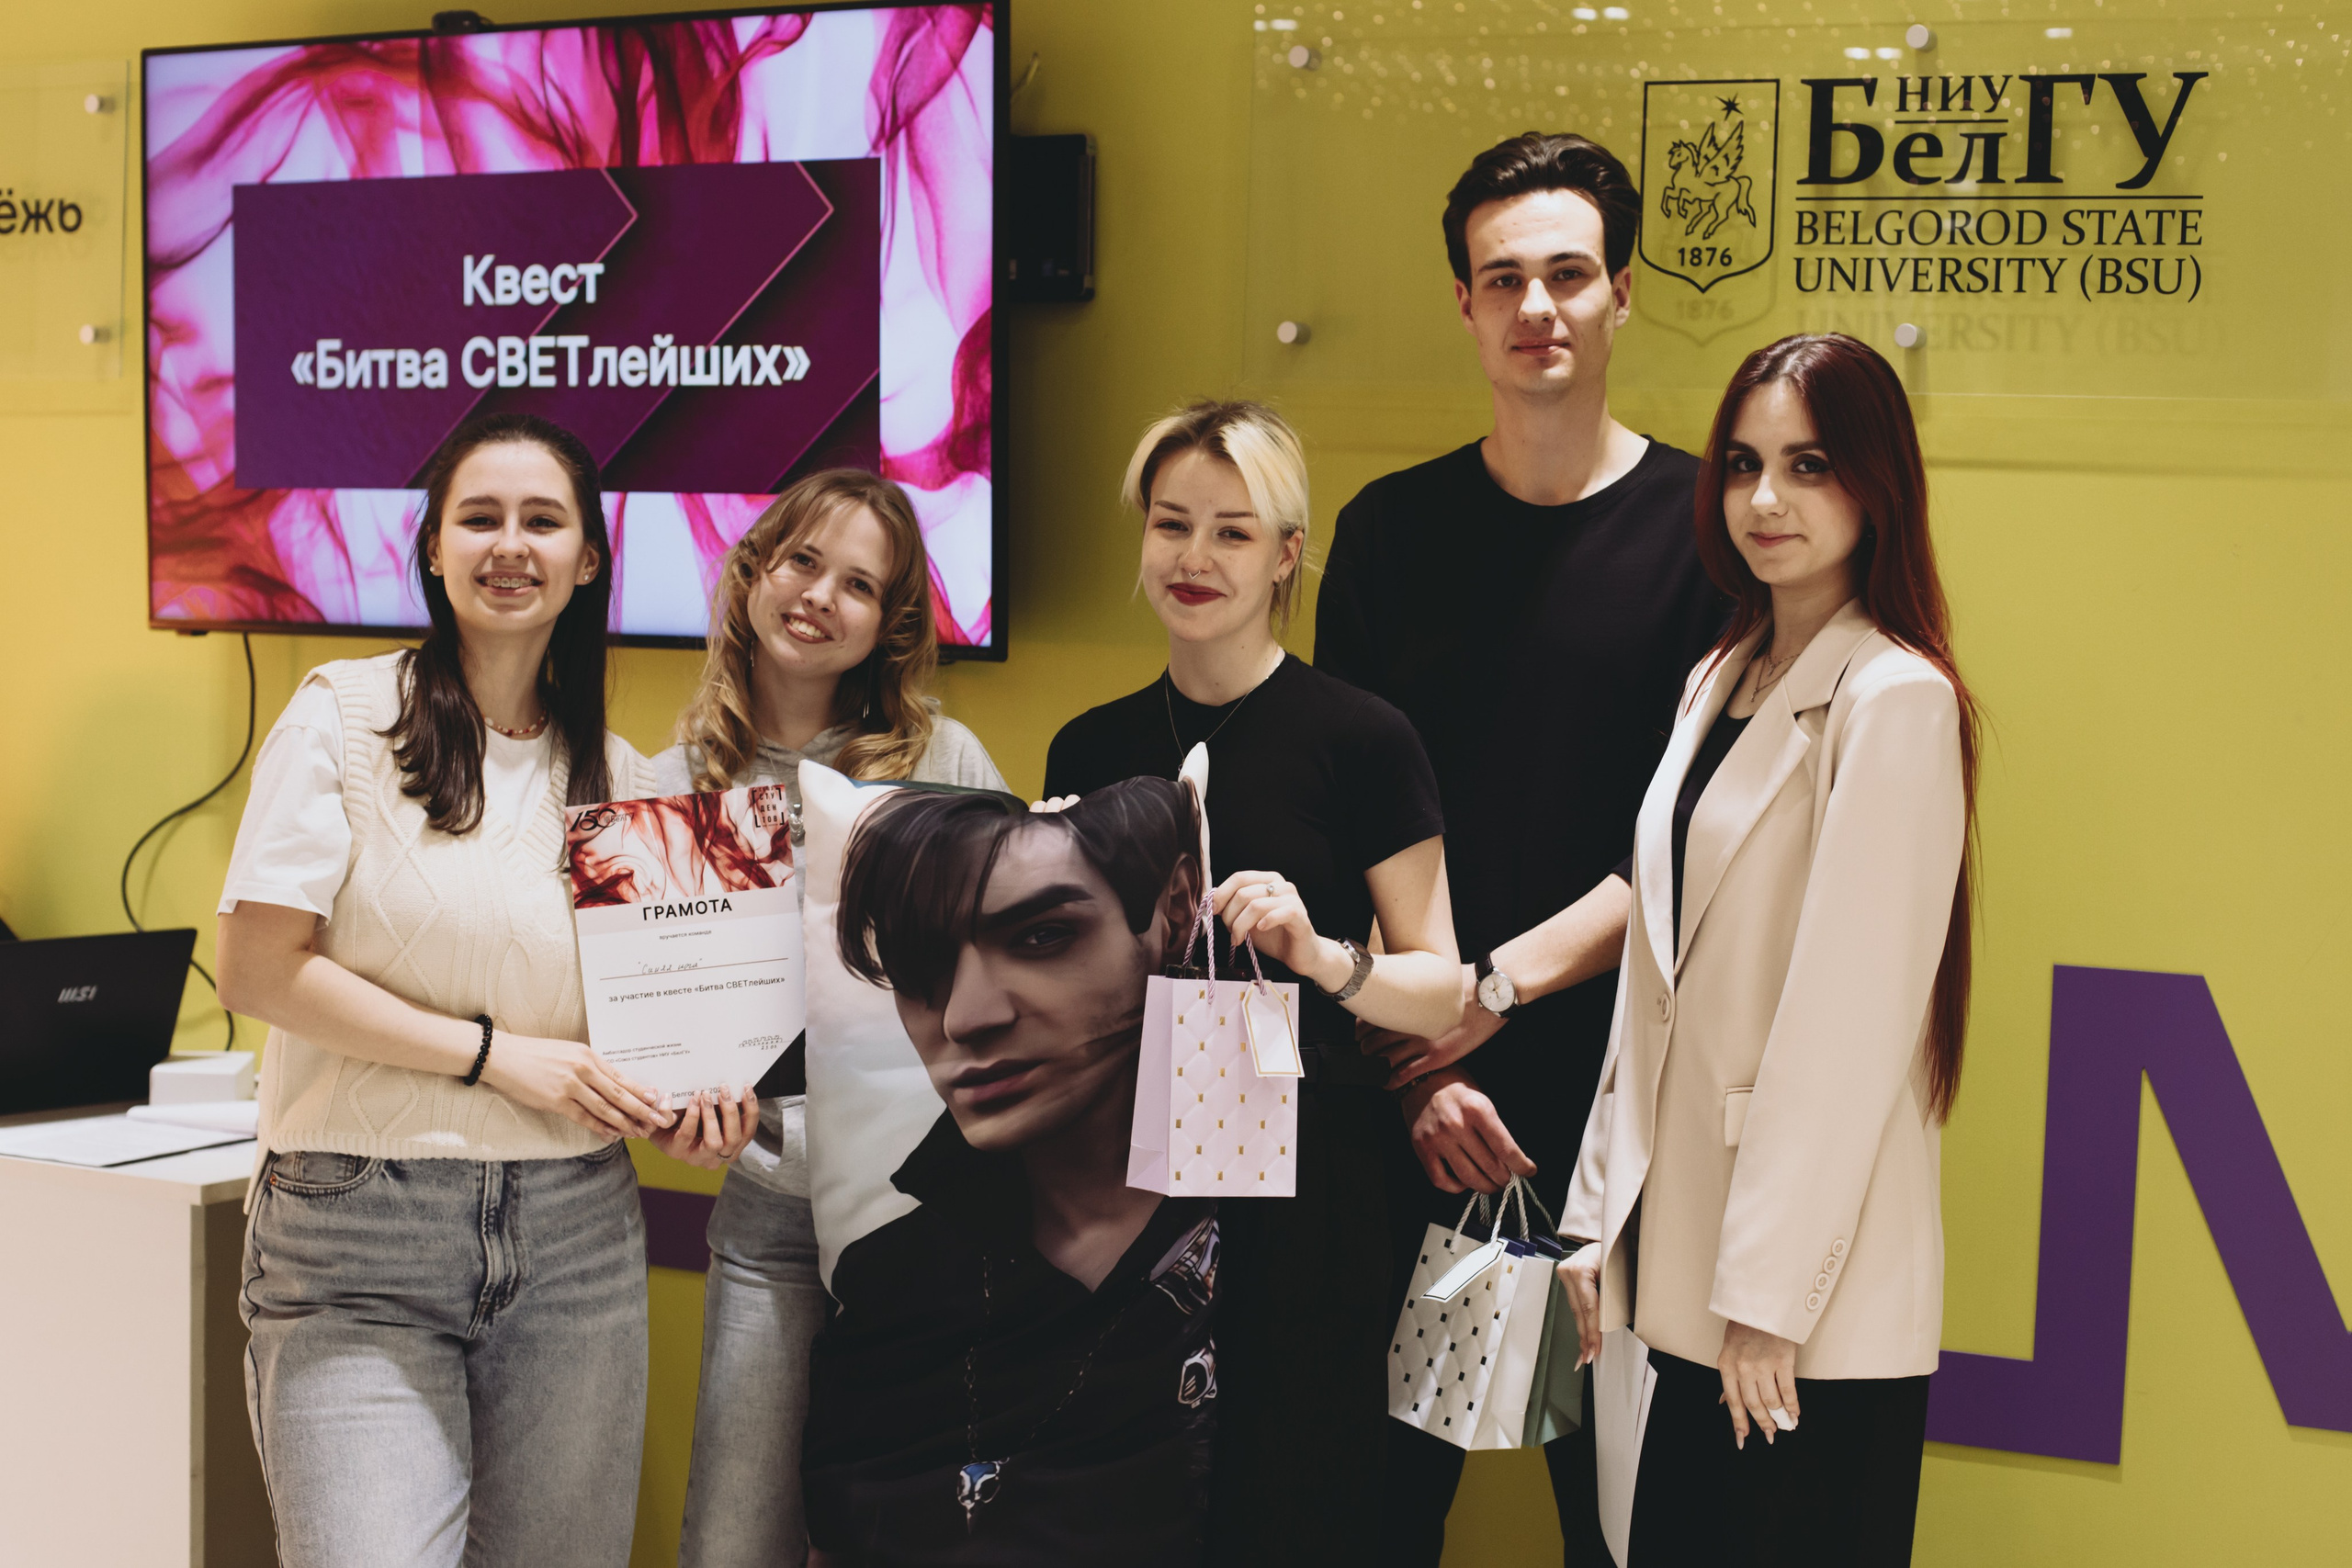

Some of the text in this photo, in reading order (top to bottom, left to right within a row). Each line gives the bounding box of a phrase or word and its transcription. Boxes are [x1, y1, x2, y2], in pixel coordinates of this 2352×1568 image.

[1895, 74, 2013, 113] НИУ
[1796, 72, 2210, 189] БелГУ
[1794, 209, 2203, 246] BELGOROD STATE
[1678, 246, 1733, 267] 1876
[462, 254, 605, 306] Квест
[1794, 254, 2202, 303] UNIVERSITY (BSU)
[290, 333, 811, 389] «Битва СВЕТлейших»
[643, 897, 732, 920] ГРАМОТА
[620, 991, 654, 1002] участие
[663, 987, 693, 996] квесте
[695, 983, 724, 993] «Битва
[726, 976, 786, 989] СВЕТлейших»
